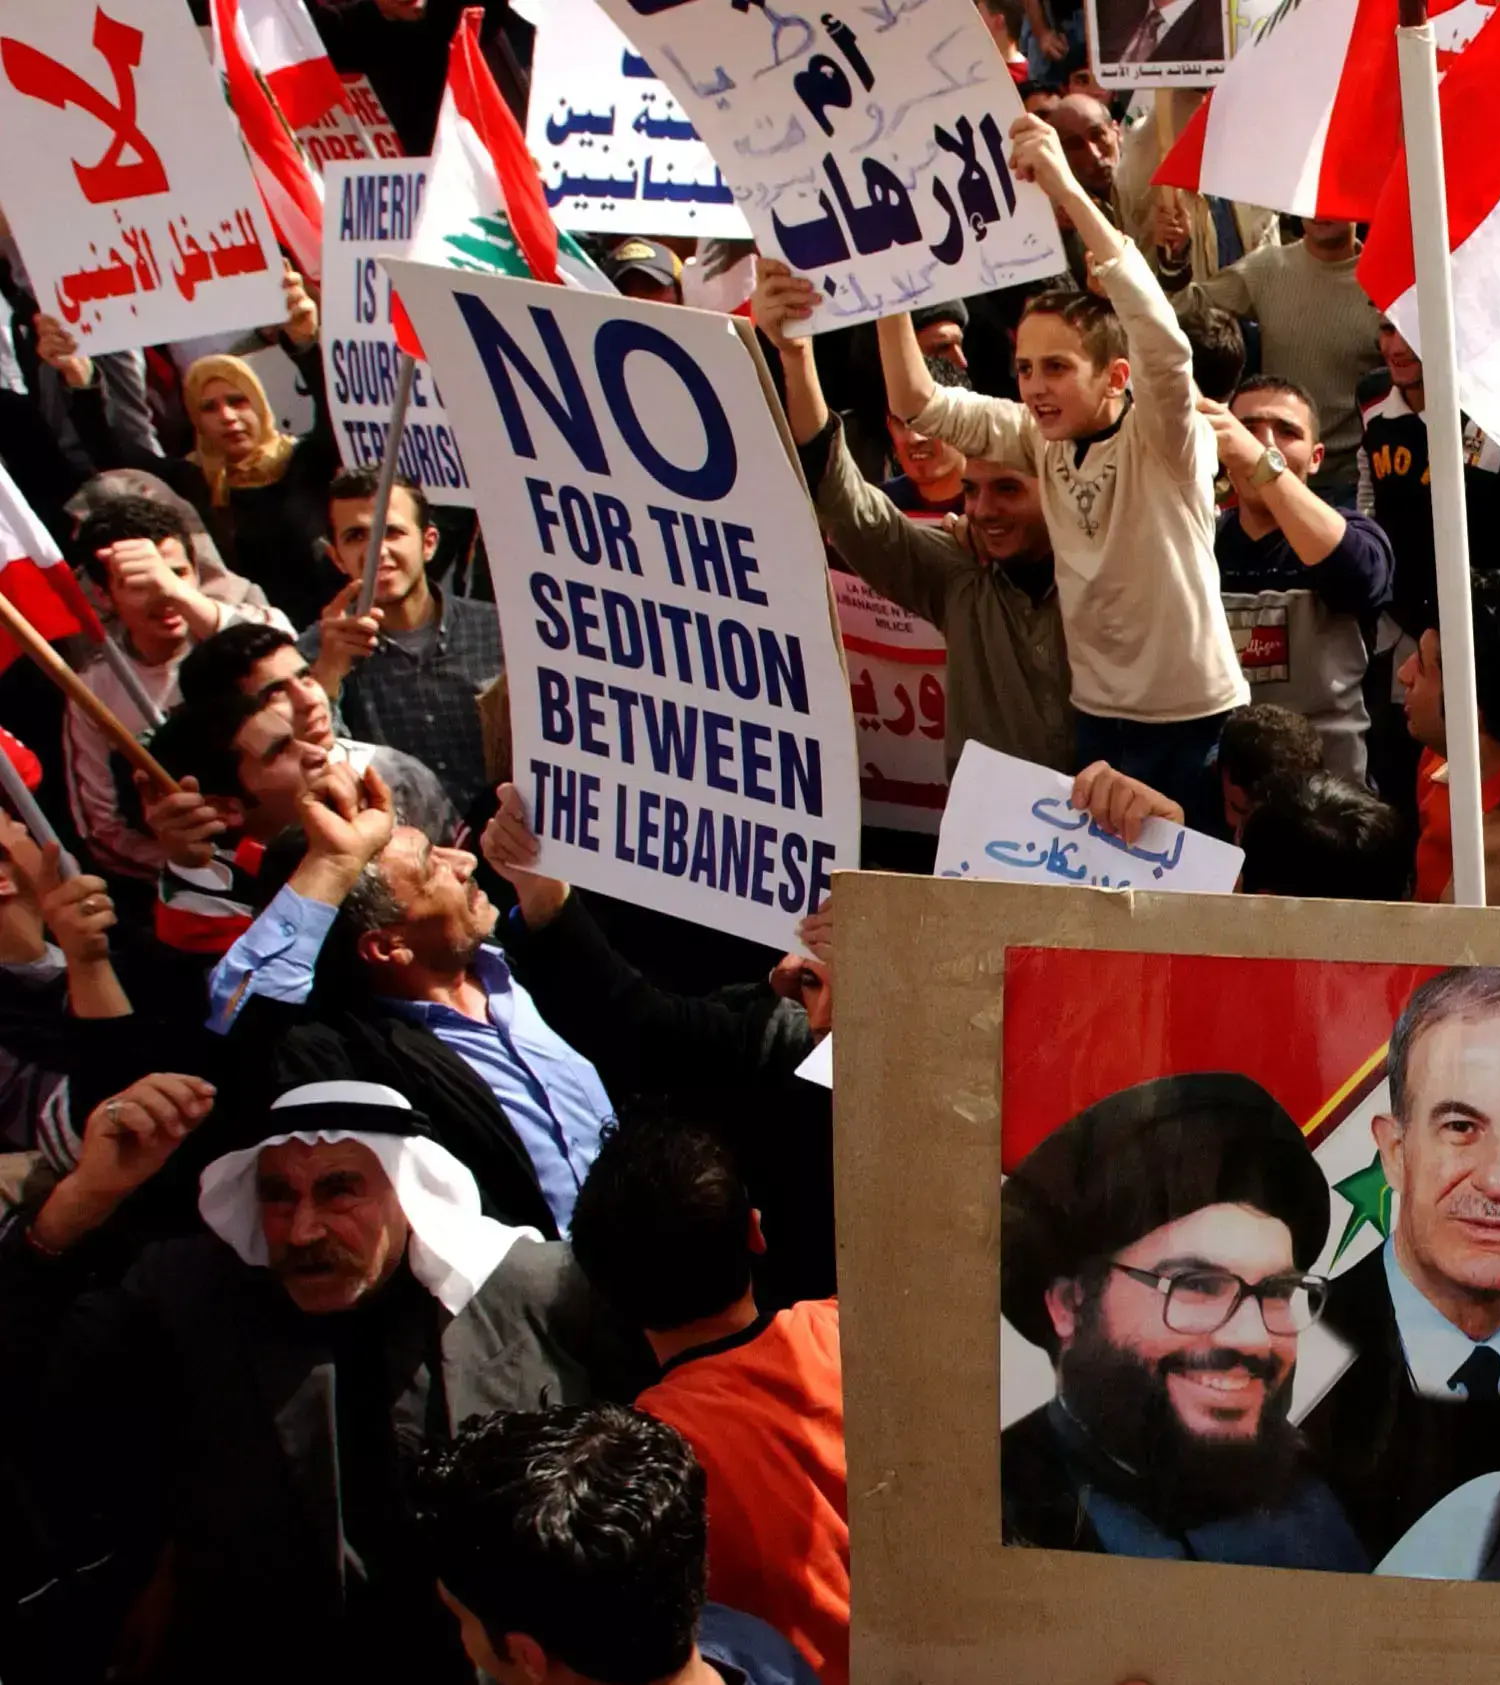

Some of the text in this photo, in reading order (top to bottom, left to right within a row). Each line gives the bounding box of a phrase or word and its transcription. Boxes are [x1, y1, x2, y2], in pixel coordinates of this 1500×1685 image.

[0, 5, 170, 204] لا
[54, 207, 163, 335] الأجنبي
[170, 206, 268, 304] للتدخل
[355, 257, 377, 324] IS
[332, 337, 429, 410] SOURE
[453, 291, 738, 502] NO
[343, 419, 470, 489] TERORIS
[525, 476, 769, 607] FOR THE
[529, 572, 810, 715] SEDITION
[536, 665, 824, 818] BETWEEN
[530, 759, 600, 853] THE
